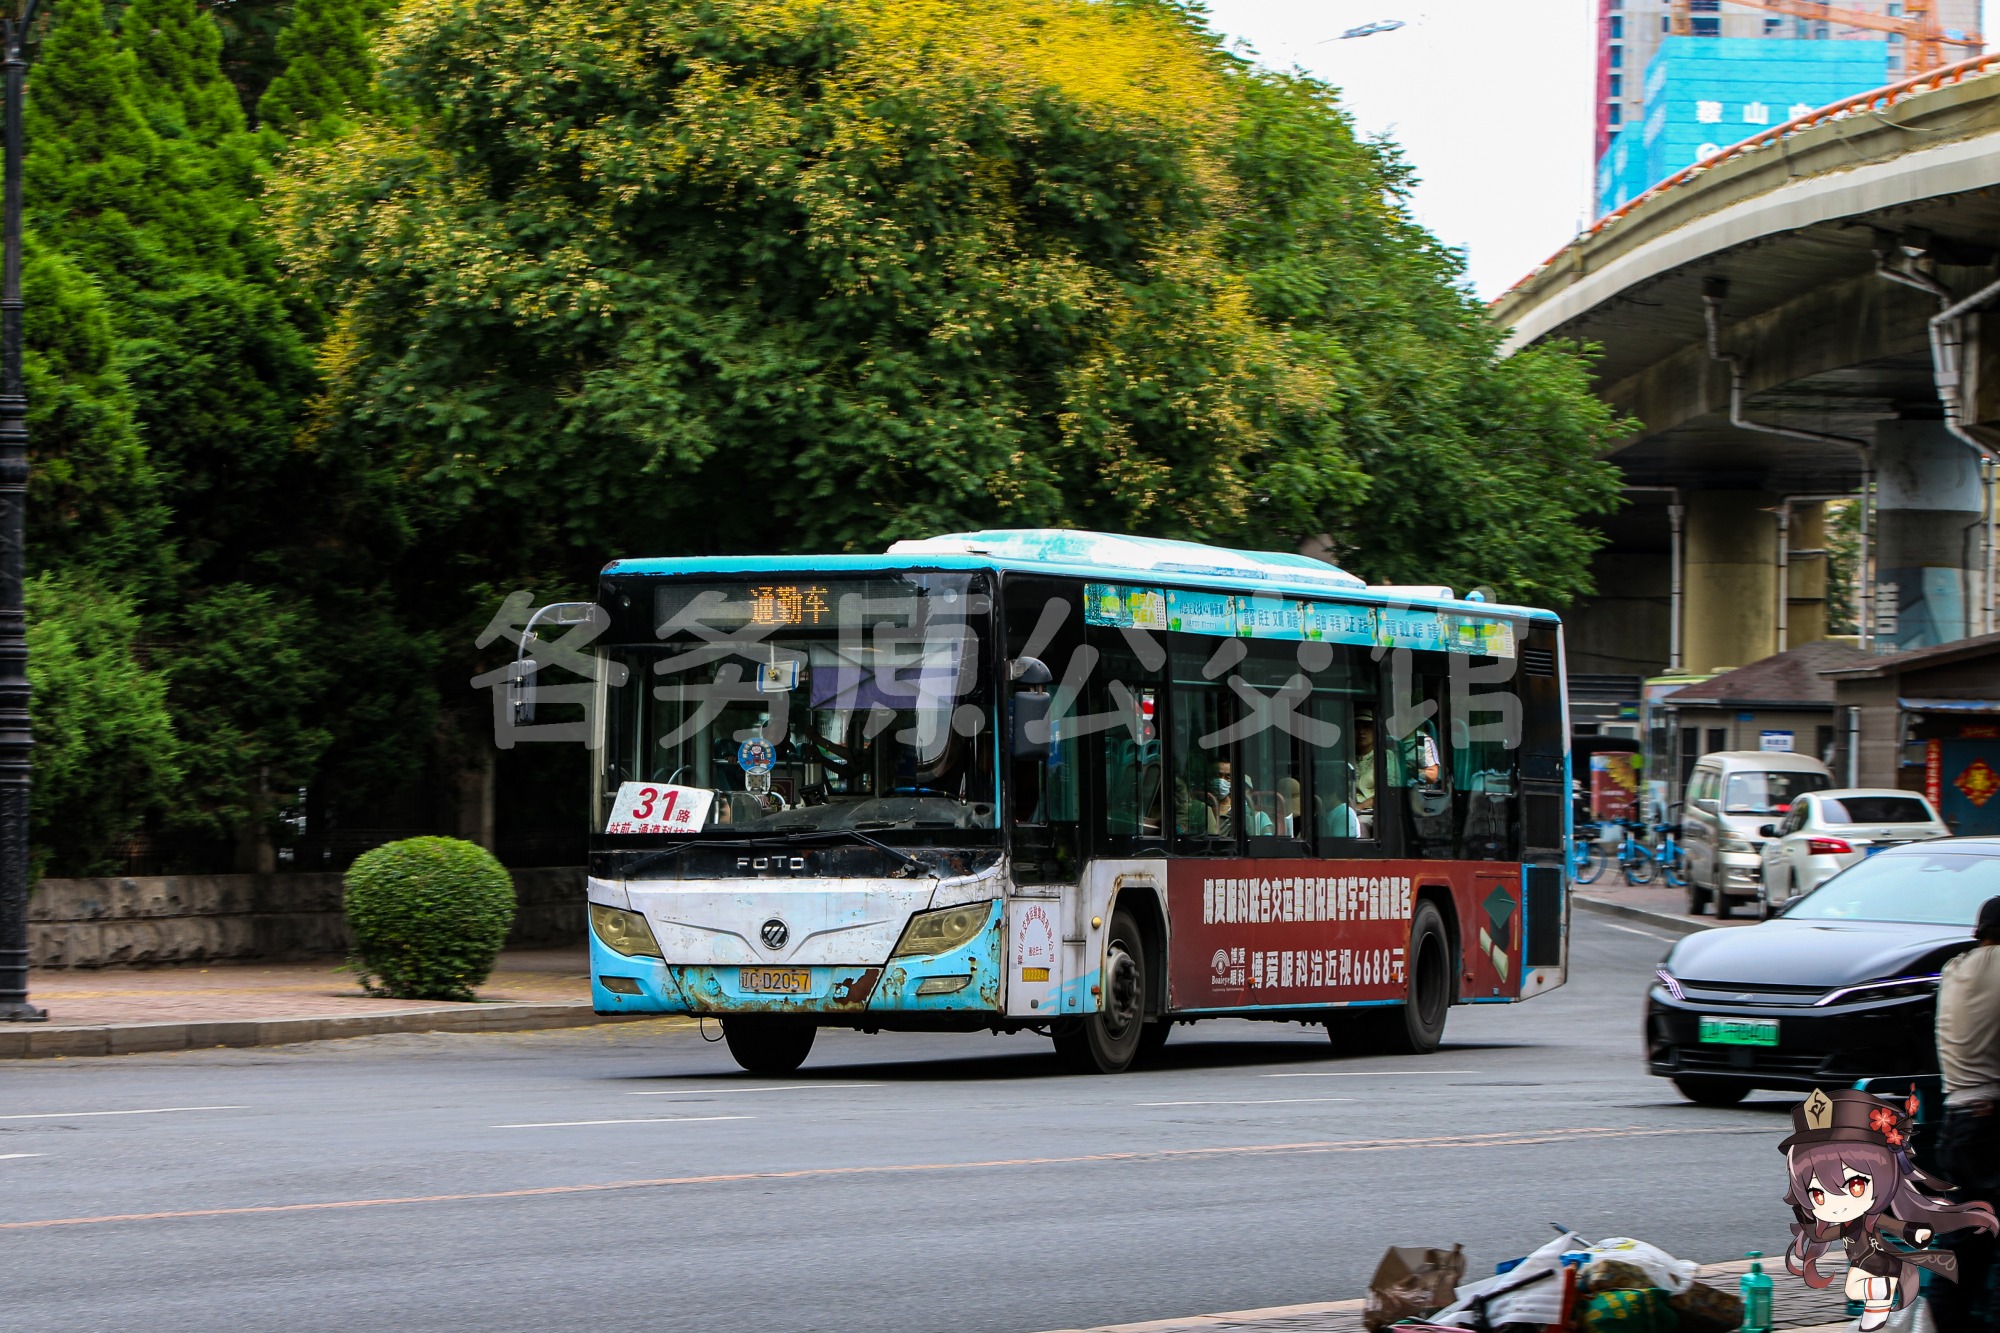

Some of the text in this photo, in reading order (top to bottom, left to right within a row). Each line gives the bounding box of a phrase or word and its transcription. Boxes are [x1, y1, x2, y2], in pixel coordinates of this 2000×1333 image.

[749, 586, 831, 625] 通勤车
[737, 855, 804, 869] FOTO
[1203, 876, 1412, 925] 博爱眼科联合交运集团祝高考学子金榜题名
[1251, 948, 1405, 989] 博爱眼科治近视6688元
